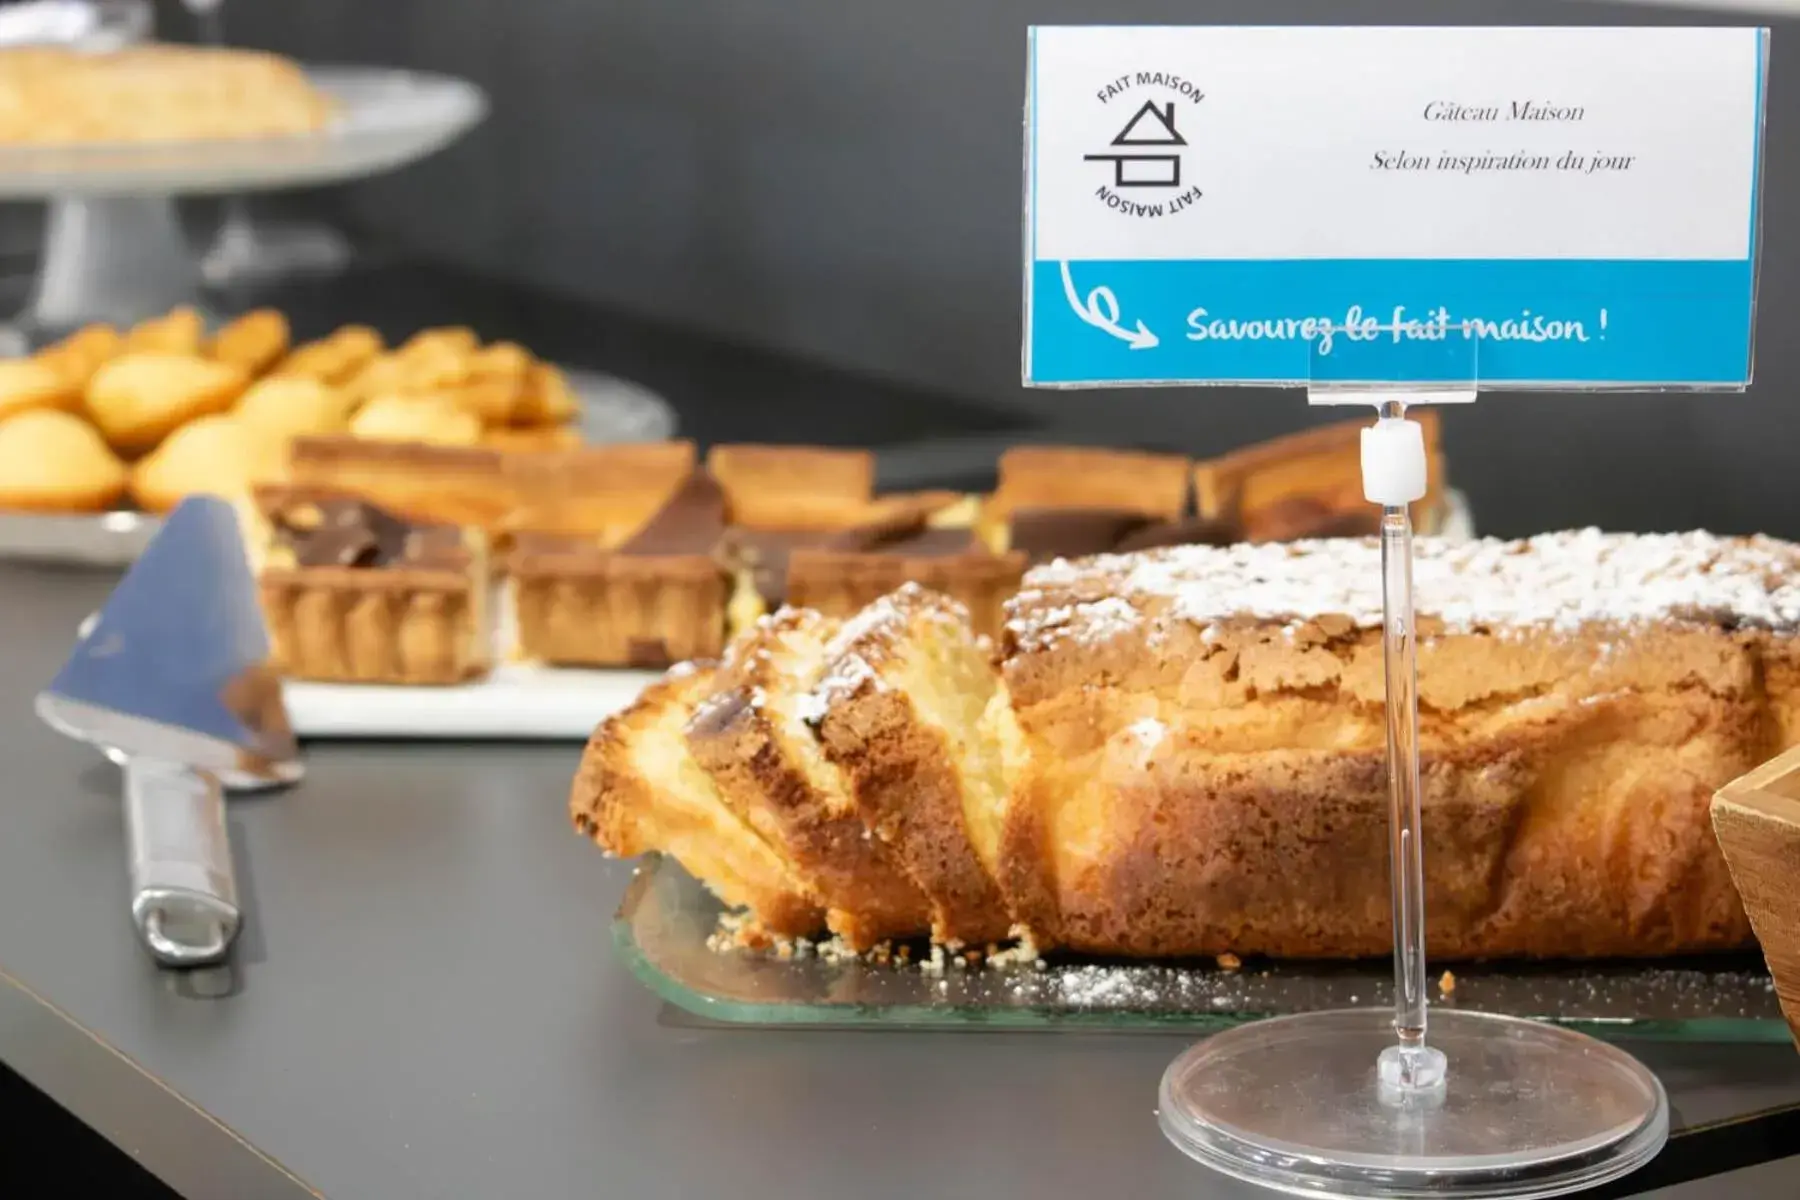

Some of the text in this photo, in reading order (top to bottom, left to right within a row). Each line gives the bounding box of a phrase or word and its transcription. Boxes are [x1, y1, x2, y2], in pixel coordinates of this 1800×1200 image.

[1096, 72, 1205, 104] FAIT MAISON
[1423, 100, 1585, 122] Gâteau Maison
[1369, 150, 1636, 175] Selon inspiration du jour
[1095, 185, 1203, 217] FAIT MAISON
[1185, 307, 1333, 356] Savourez
[1344, 305, 1378, 341] le
[1391, 305, 1452, 343] fait
